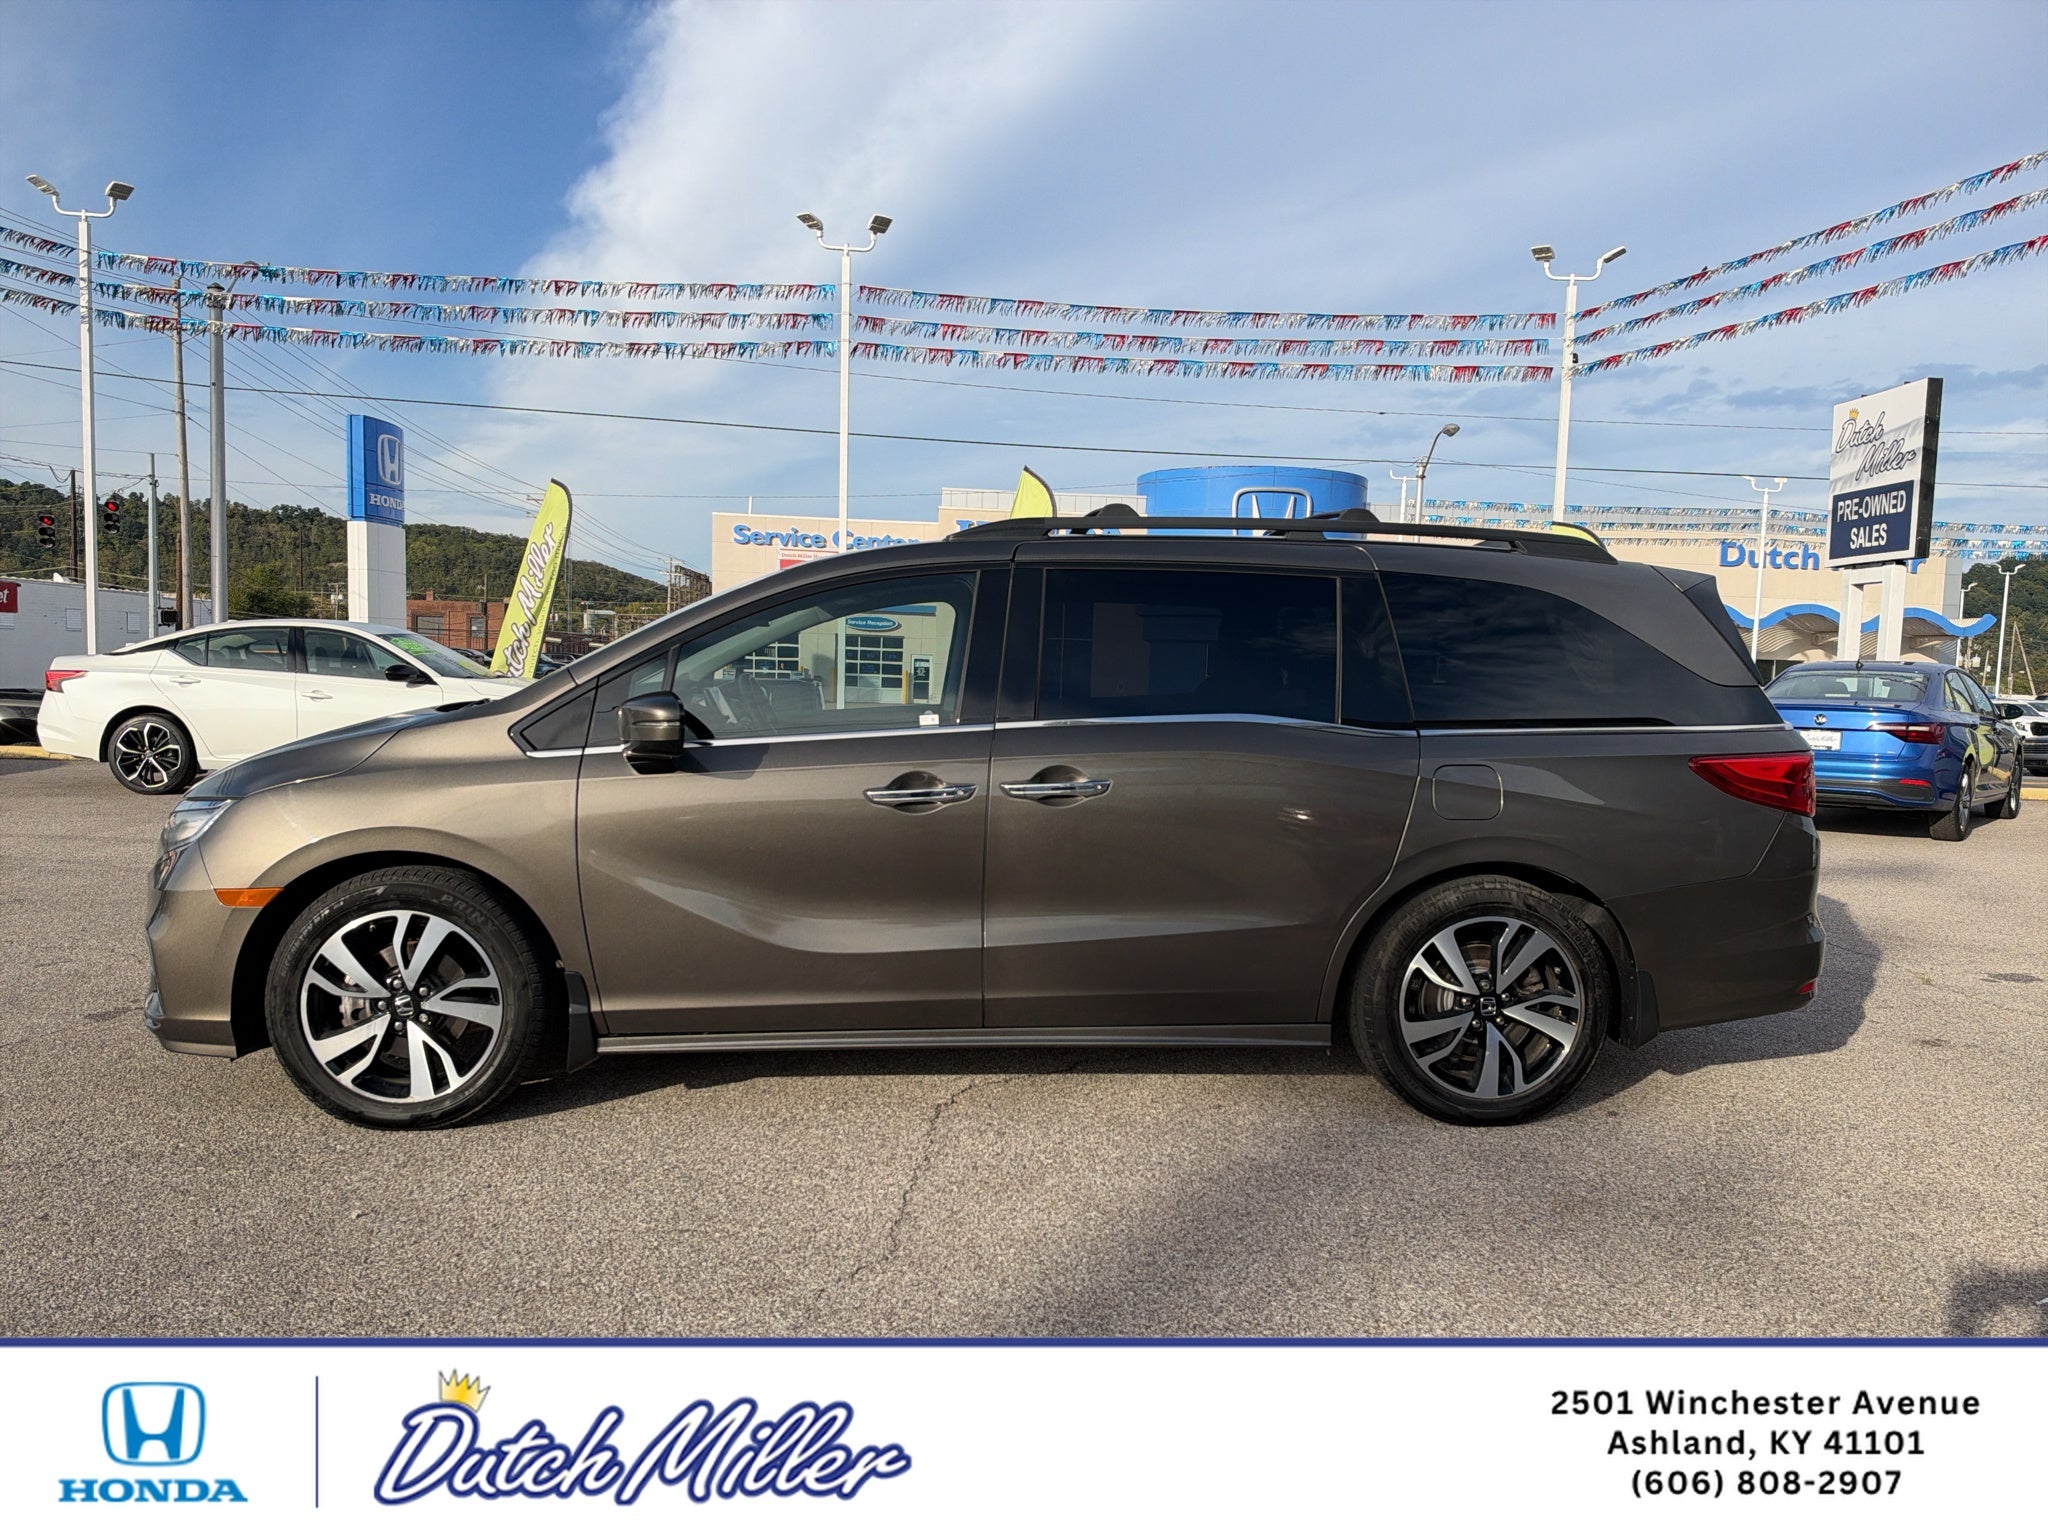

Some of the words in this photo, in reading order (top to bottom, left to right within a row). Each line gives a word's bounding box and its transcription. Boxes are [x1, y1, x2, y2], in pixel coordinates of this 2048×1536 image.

[1836, 411, 1885, 453] Dutch
[1855, 438, 1917, 481] Miller
[369, 493, 404, 511] HOND
[1837, 490, 1906, 522] PRE-OWNED
[733, 524, 826, 548] Service
[1850, 523, 1887, 550] SALES
[1719, 540, 1820, 570] Dutch
[516, 522, 556, 626] Miller
[847, 618, 867, 626] Service
[867, 619, 894, 628] Reception
